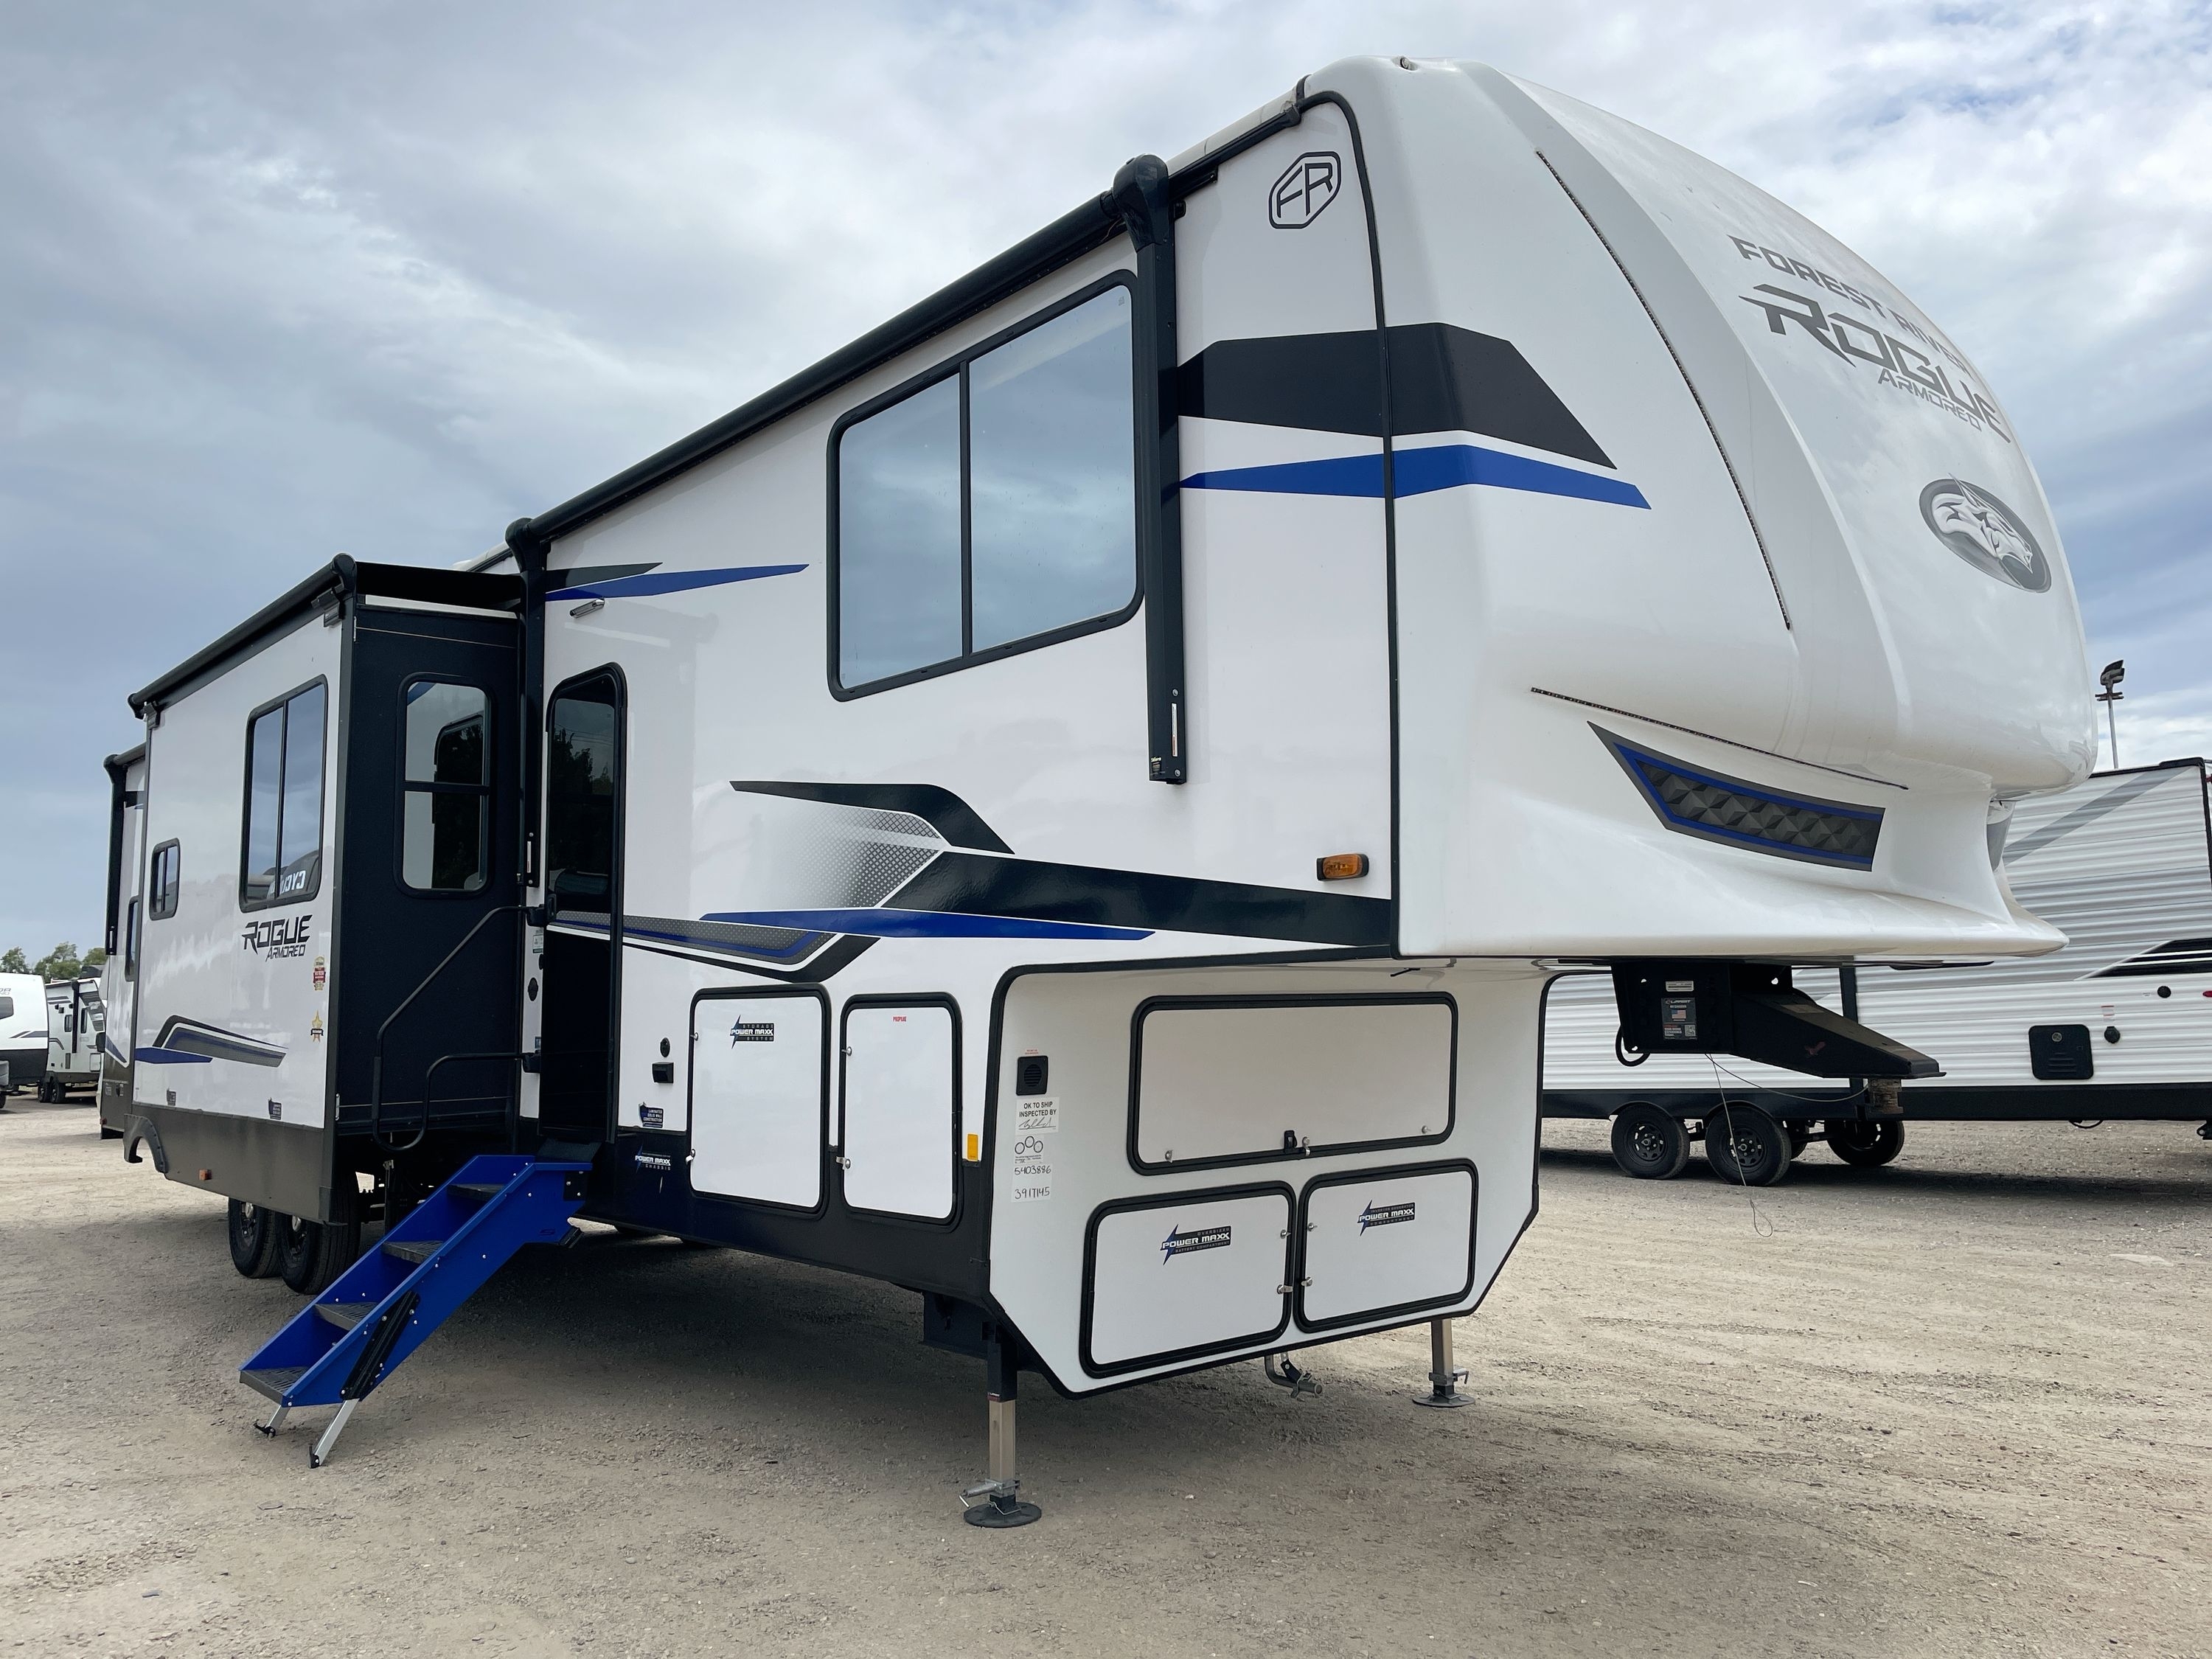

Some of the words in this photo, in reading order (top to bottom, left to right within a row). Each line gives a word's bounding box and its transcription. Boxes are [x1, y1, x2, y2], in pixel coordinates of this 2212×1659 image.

[1726, 234, 1888, 319] FOREST
[1885, 306, 1978, 383] RIVER
[1738, 283, 2011, 443] ROGUE
[1877, 368, 1982, 432] ARMORED
[241, 914, 313, 955] ROGUE
[265, 944, 306, 962] ARMORED
[1019, 1109, 1048, 1118] INSPECTED
[635, 1155, 654, 1163] POWER
[655, 1158, 671, 1166] MAXX
[1359, 1211, 1389, 1222] POWER
[1391, 1208, 1414, 1217] MAXX
[1197, 1227, 1230, 1236] OVERSIZED
[1162, 1237, 1199, 1248] POWER
[1201, 1232, 1230, 1242] MAXX
[1196, 1240, 1230, 1251] COMPARTMENT
